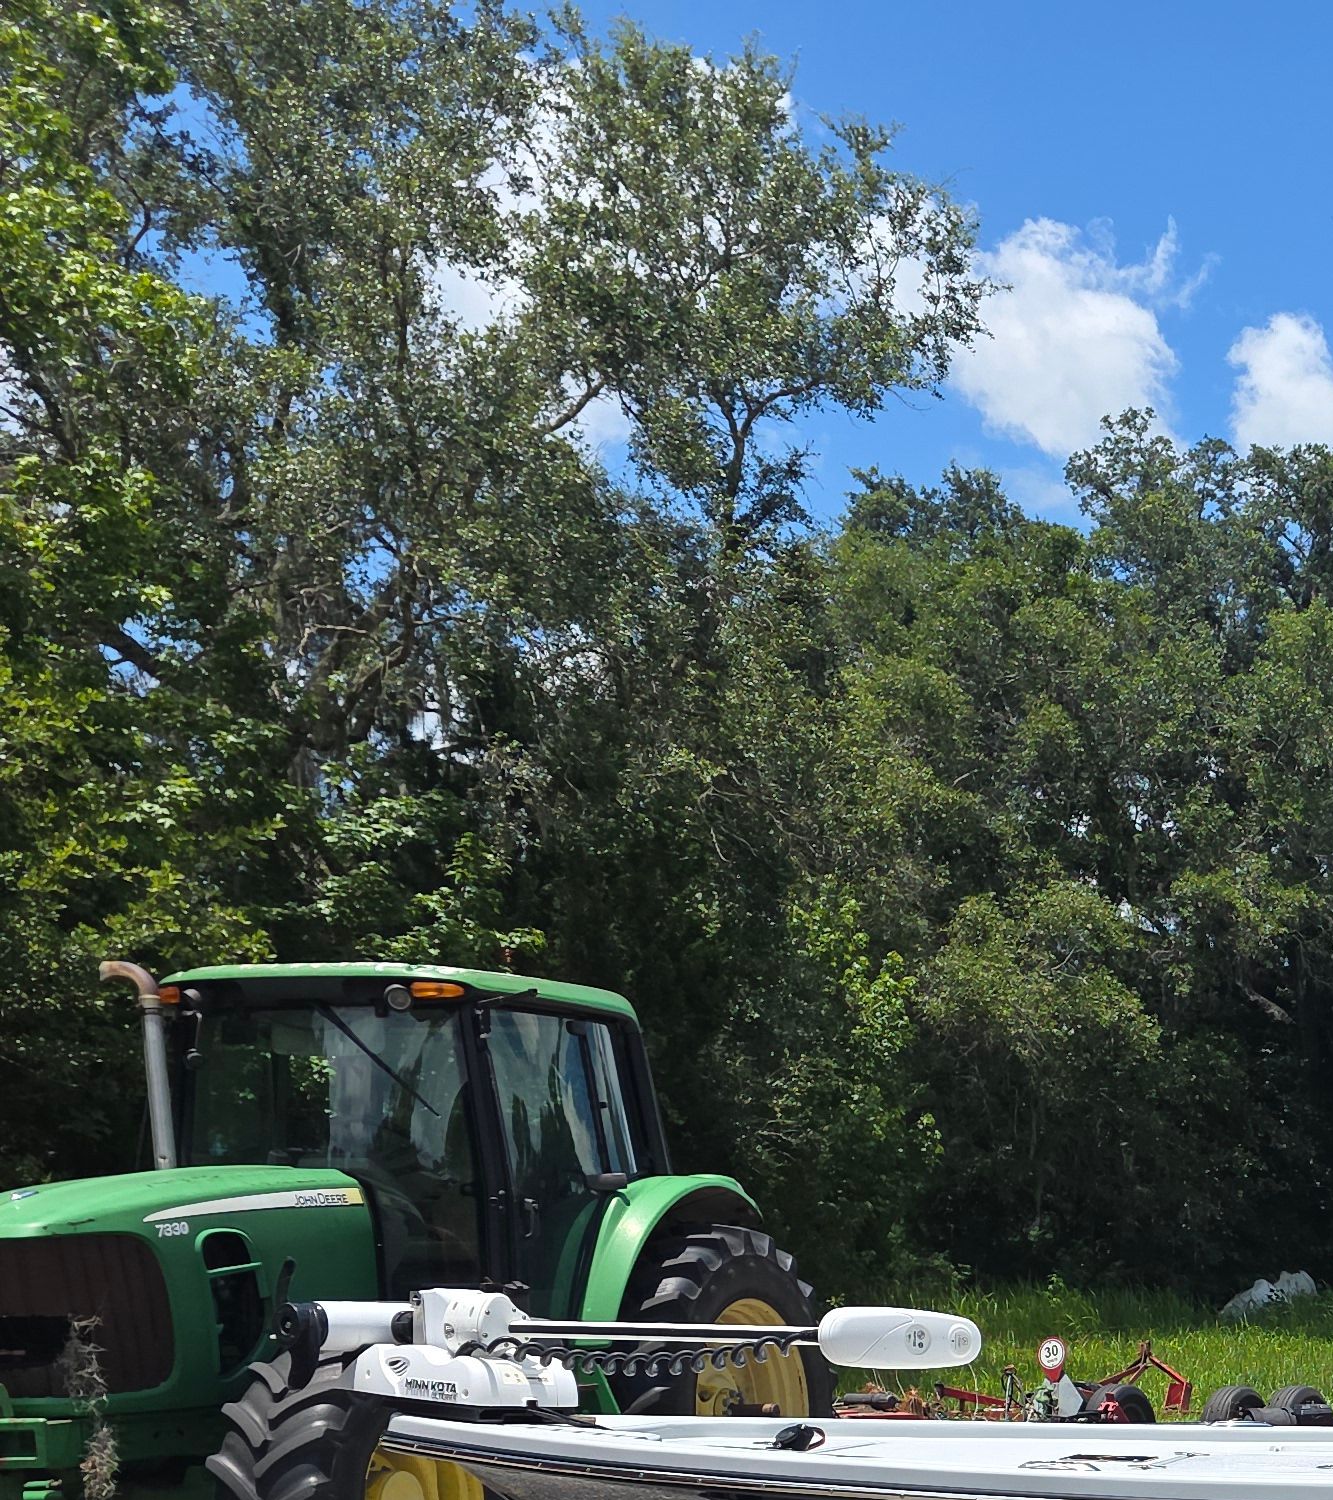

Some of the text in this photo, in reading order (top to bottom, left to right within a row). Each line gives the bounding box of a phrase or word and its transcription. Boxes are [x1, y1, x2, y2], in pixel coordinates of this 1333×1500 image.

[295, 1193, 349, 1207] JOHN DEERE
[155, 1222, 190, 1238] 7330
[1044, 1344, 1059, 1359] 30
[430, 1381, 457, 1393] KOTA
